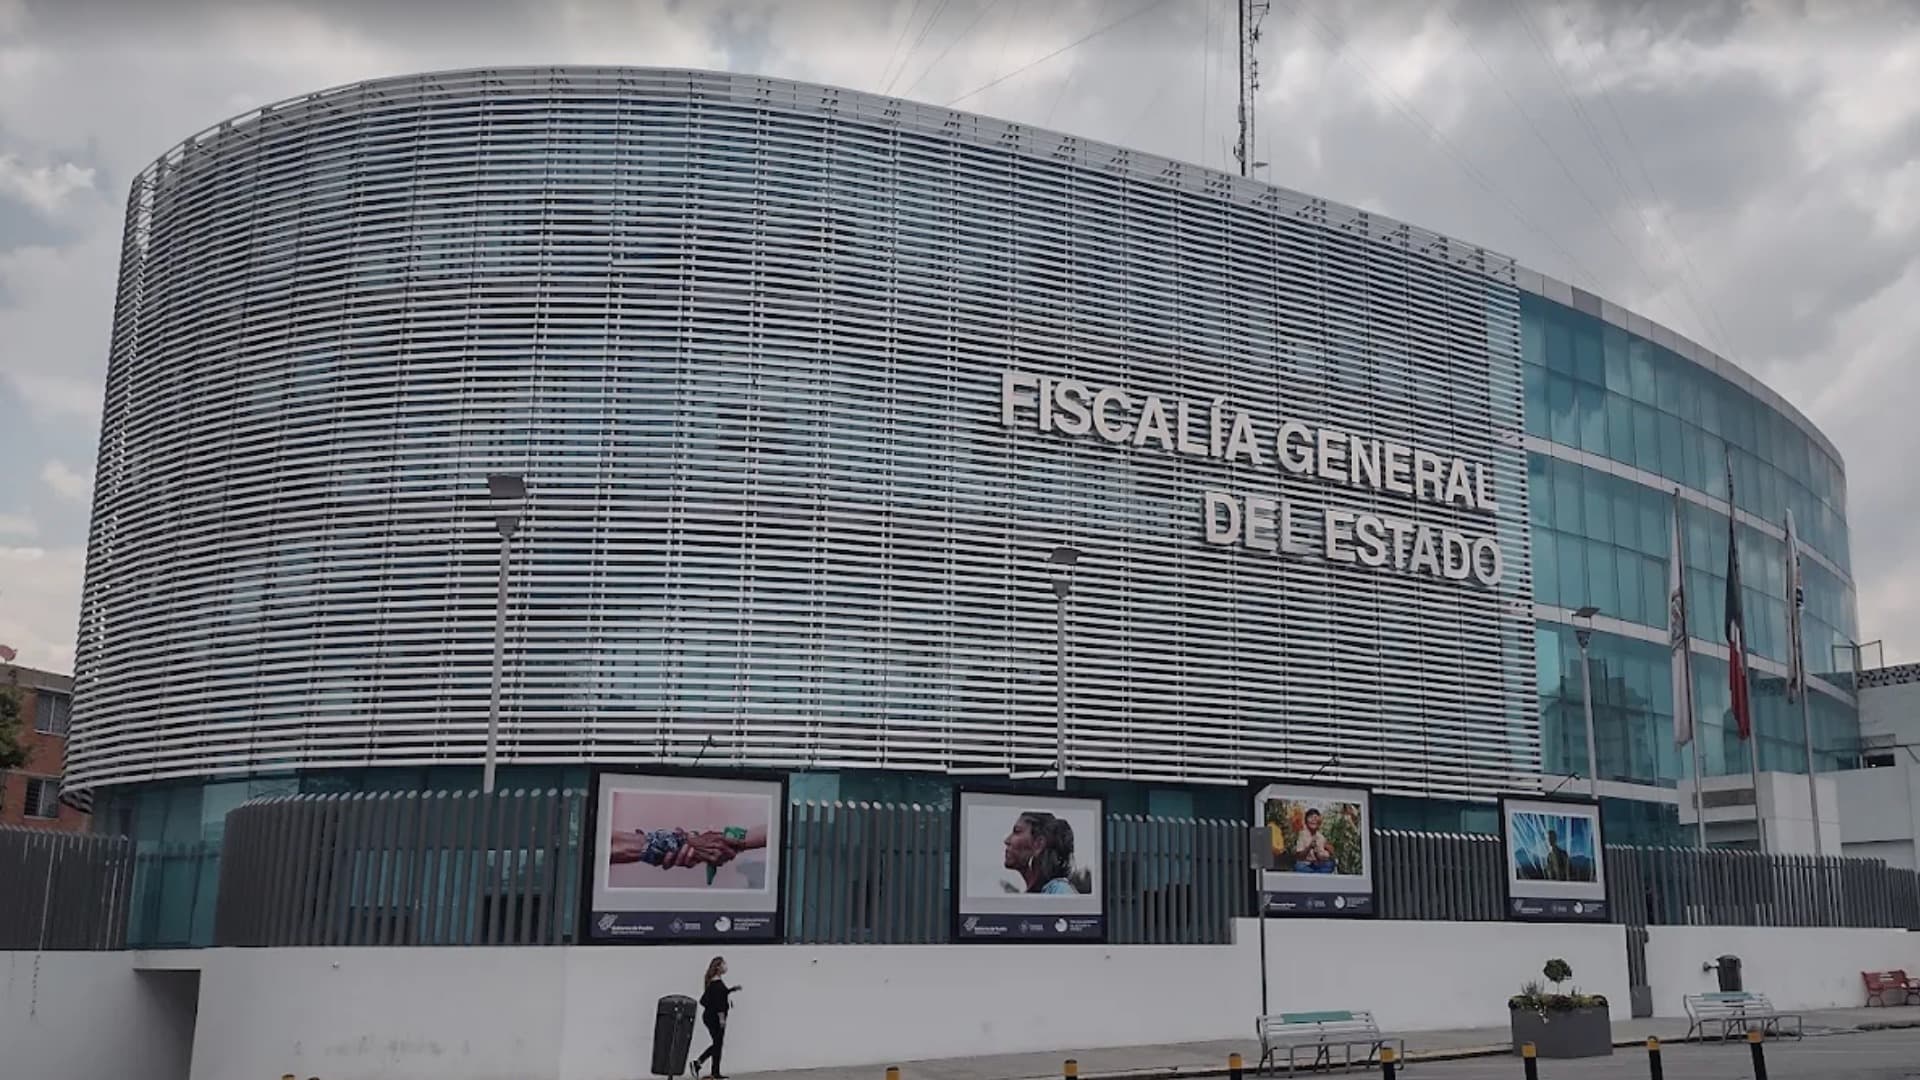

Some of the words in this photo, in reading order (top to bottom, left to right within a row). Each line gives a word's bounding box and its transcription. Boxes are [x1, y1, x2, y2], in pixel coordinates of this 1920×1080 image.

[1001, 372, 1262, 465] FISCALÍA
[1277, 420, 1497, 511] GENERAL
[1205, 490, 1304, 553] DEL
[1324, 510, 1501, 586] ESTADO
